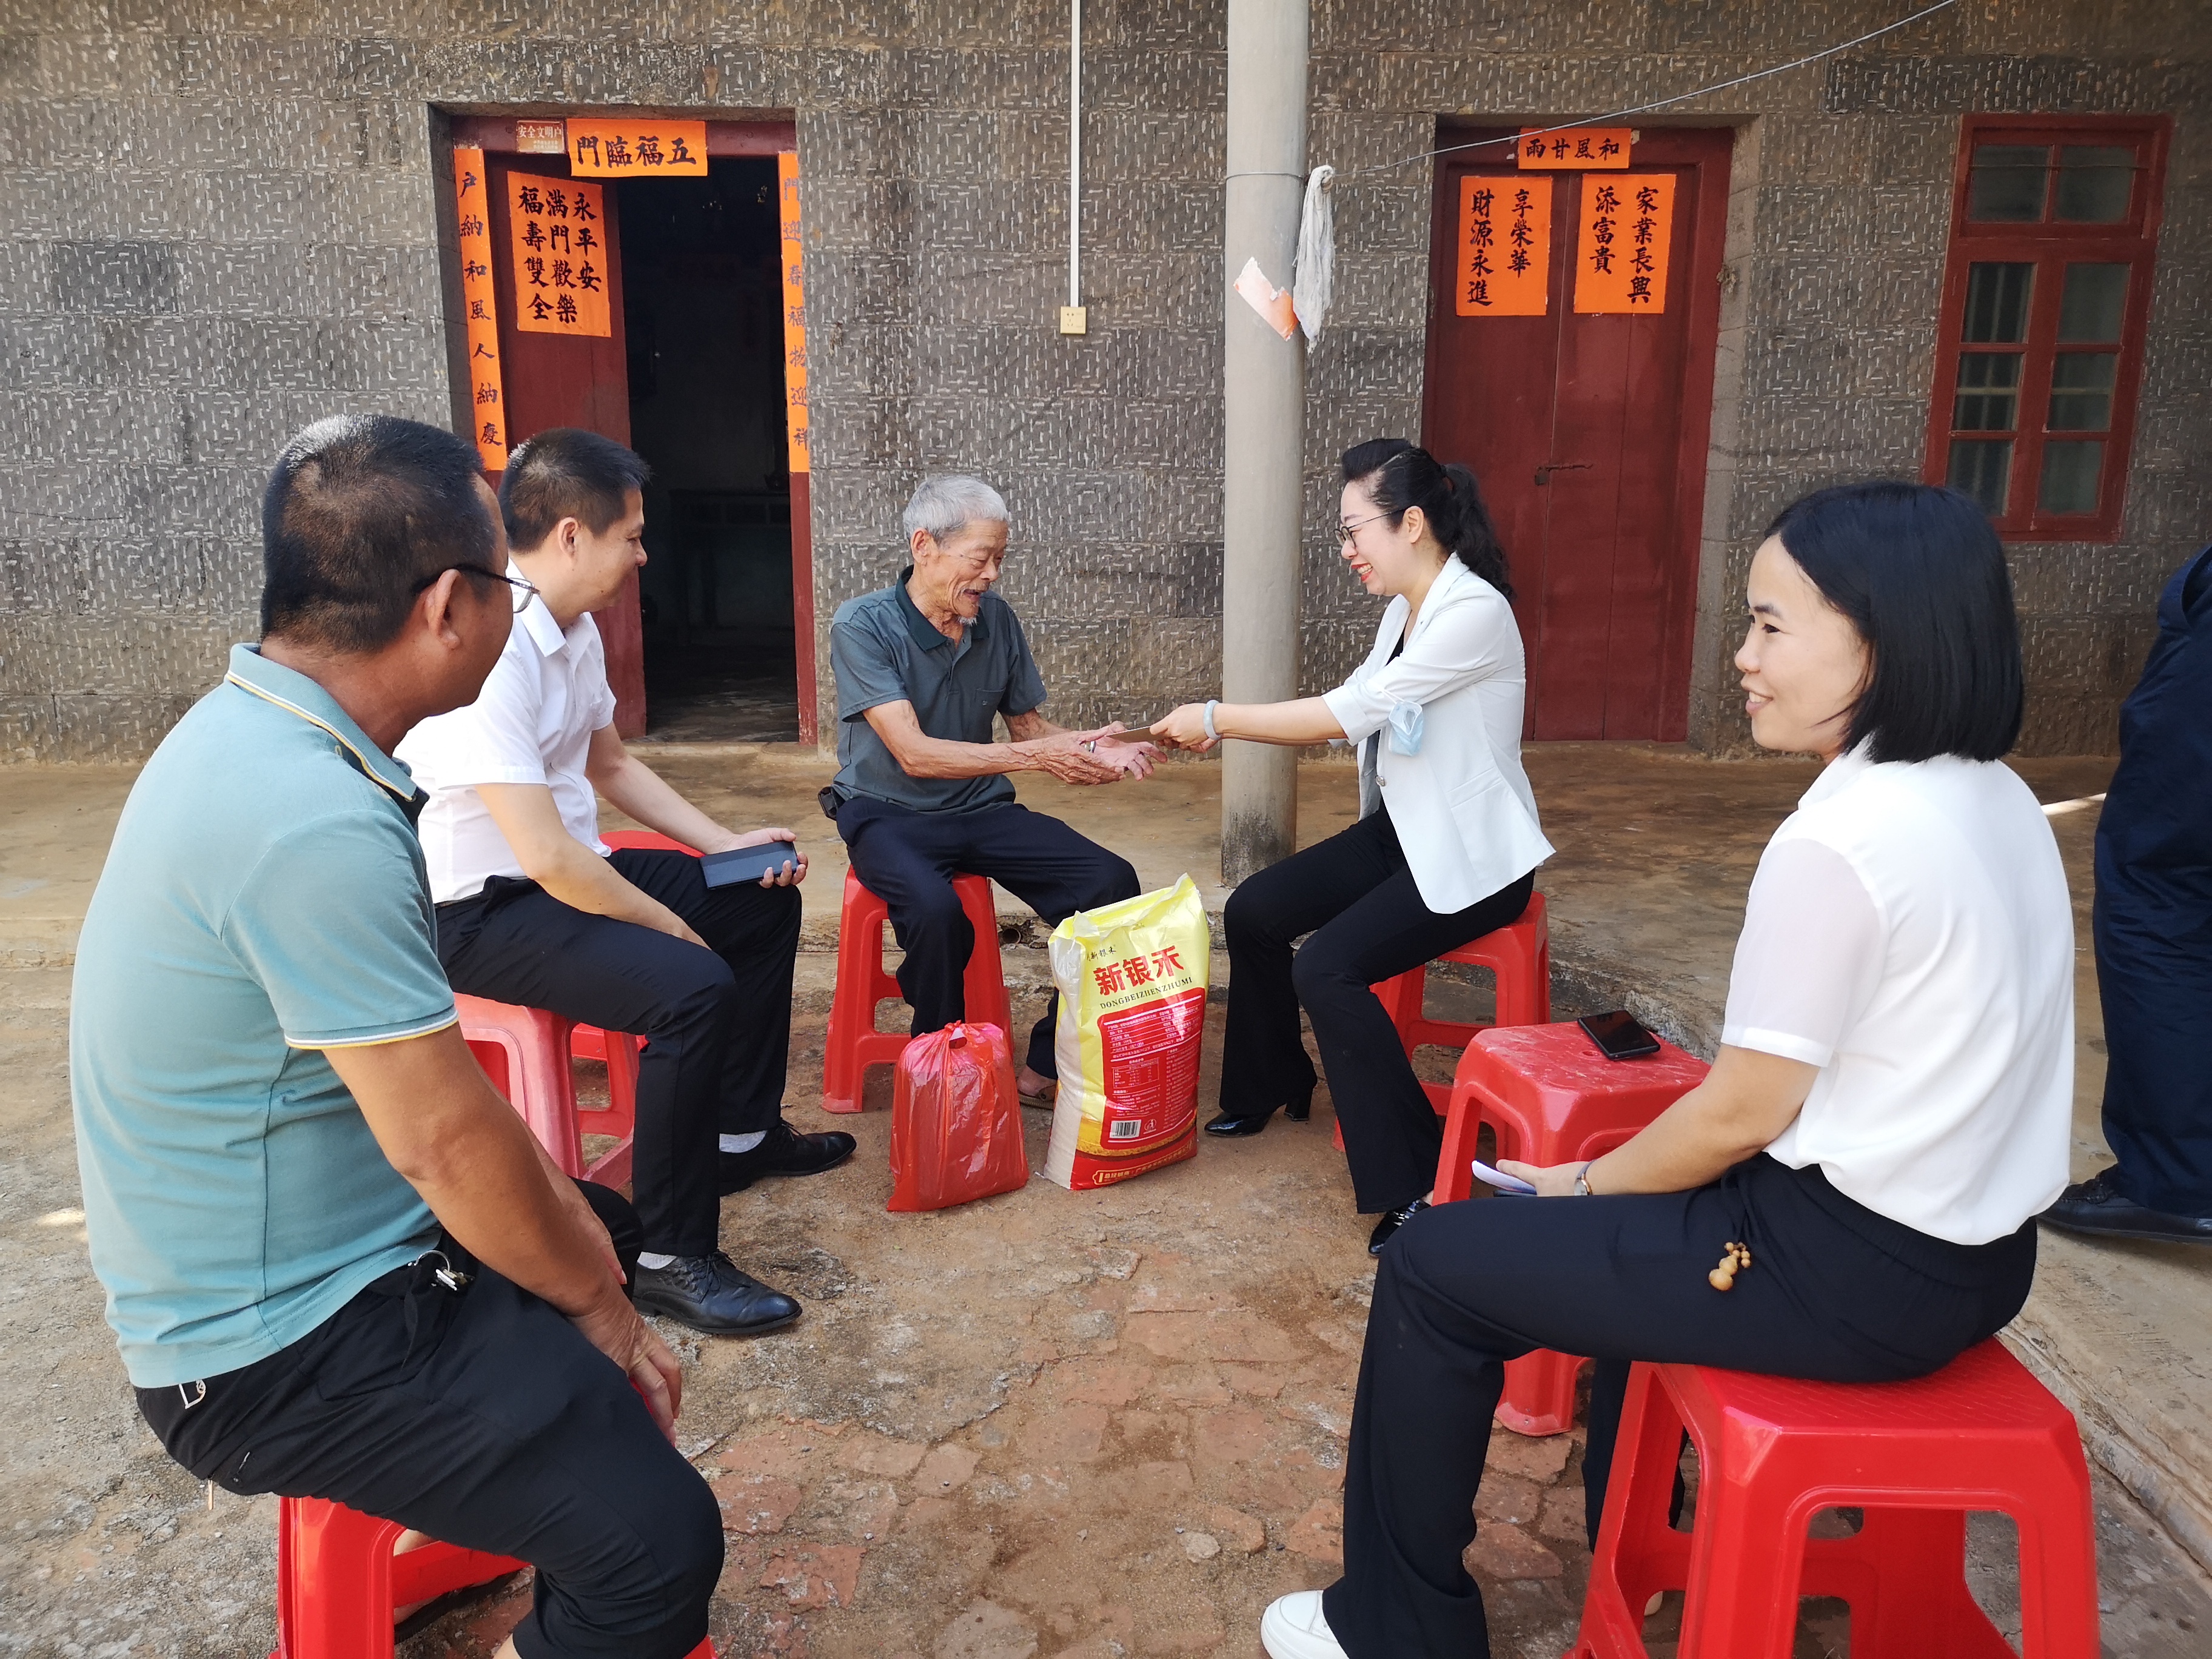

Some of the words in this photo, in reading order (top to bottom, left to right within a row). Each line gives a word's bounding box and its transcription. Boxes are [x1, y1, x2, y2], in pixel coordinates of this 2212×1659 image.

[518, 186, 554, 320] 福壽雙全
[572, 192, 602, 292] 永平安
[1507, 189, 1534, 278] 享榮華
[1627, 186, 1659, 304] 家業長興
[1093, 945, 1184, 996] 新银禾
[1099, 977, 1193, 1009] DONGBEIZHENZHUMI
